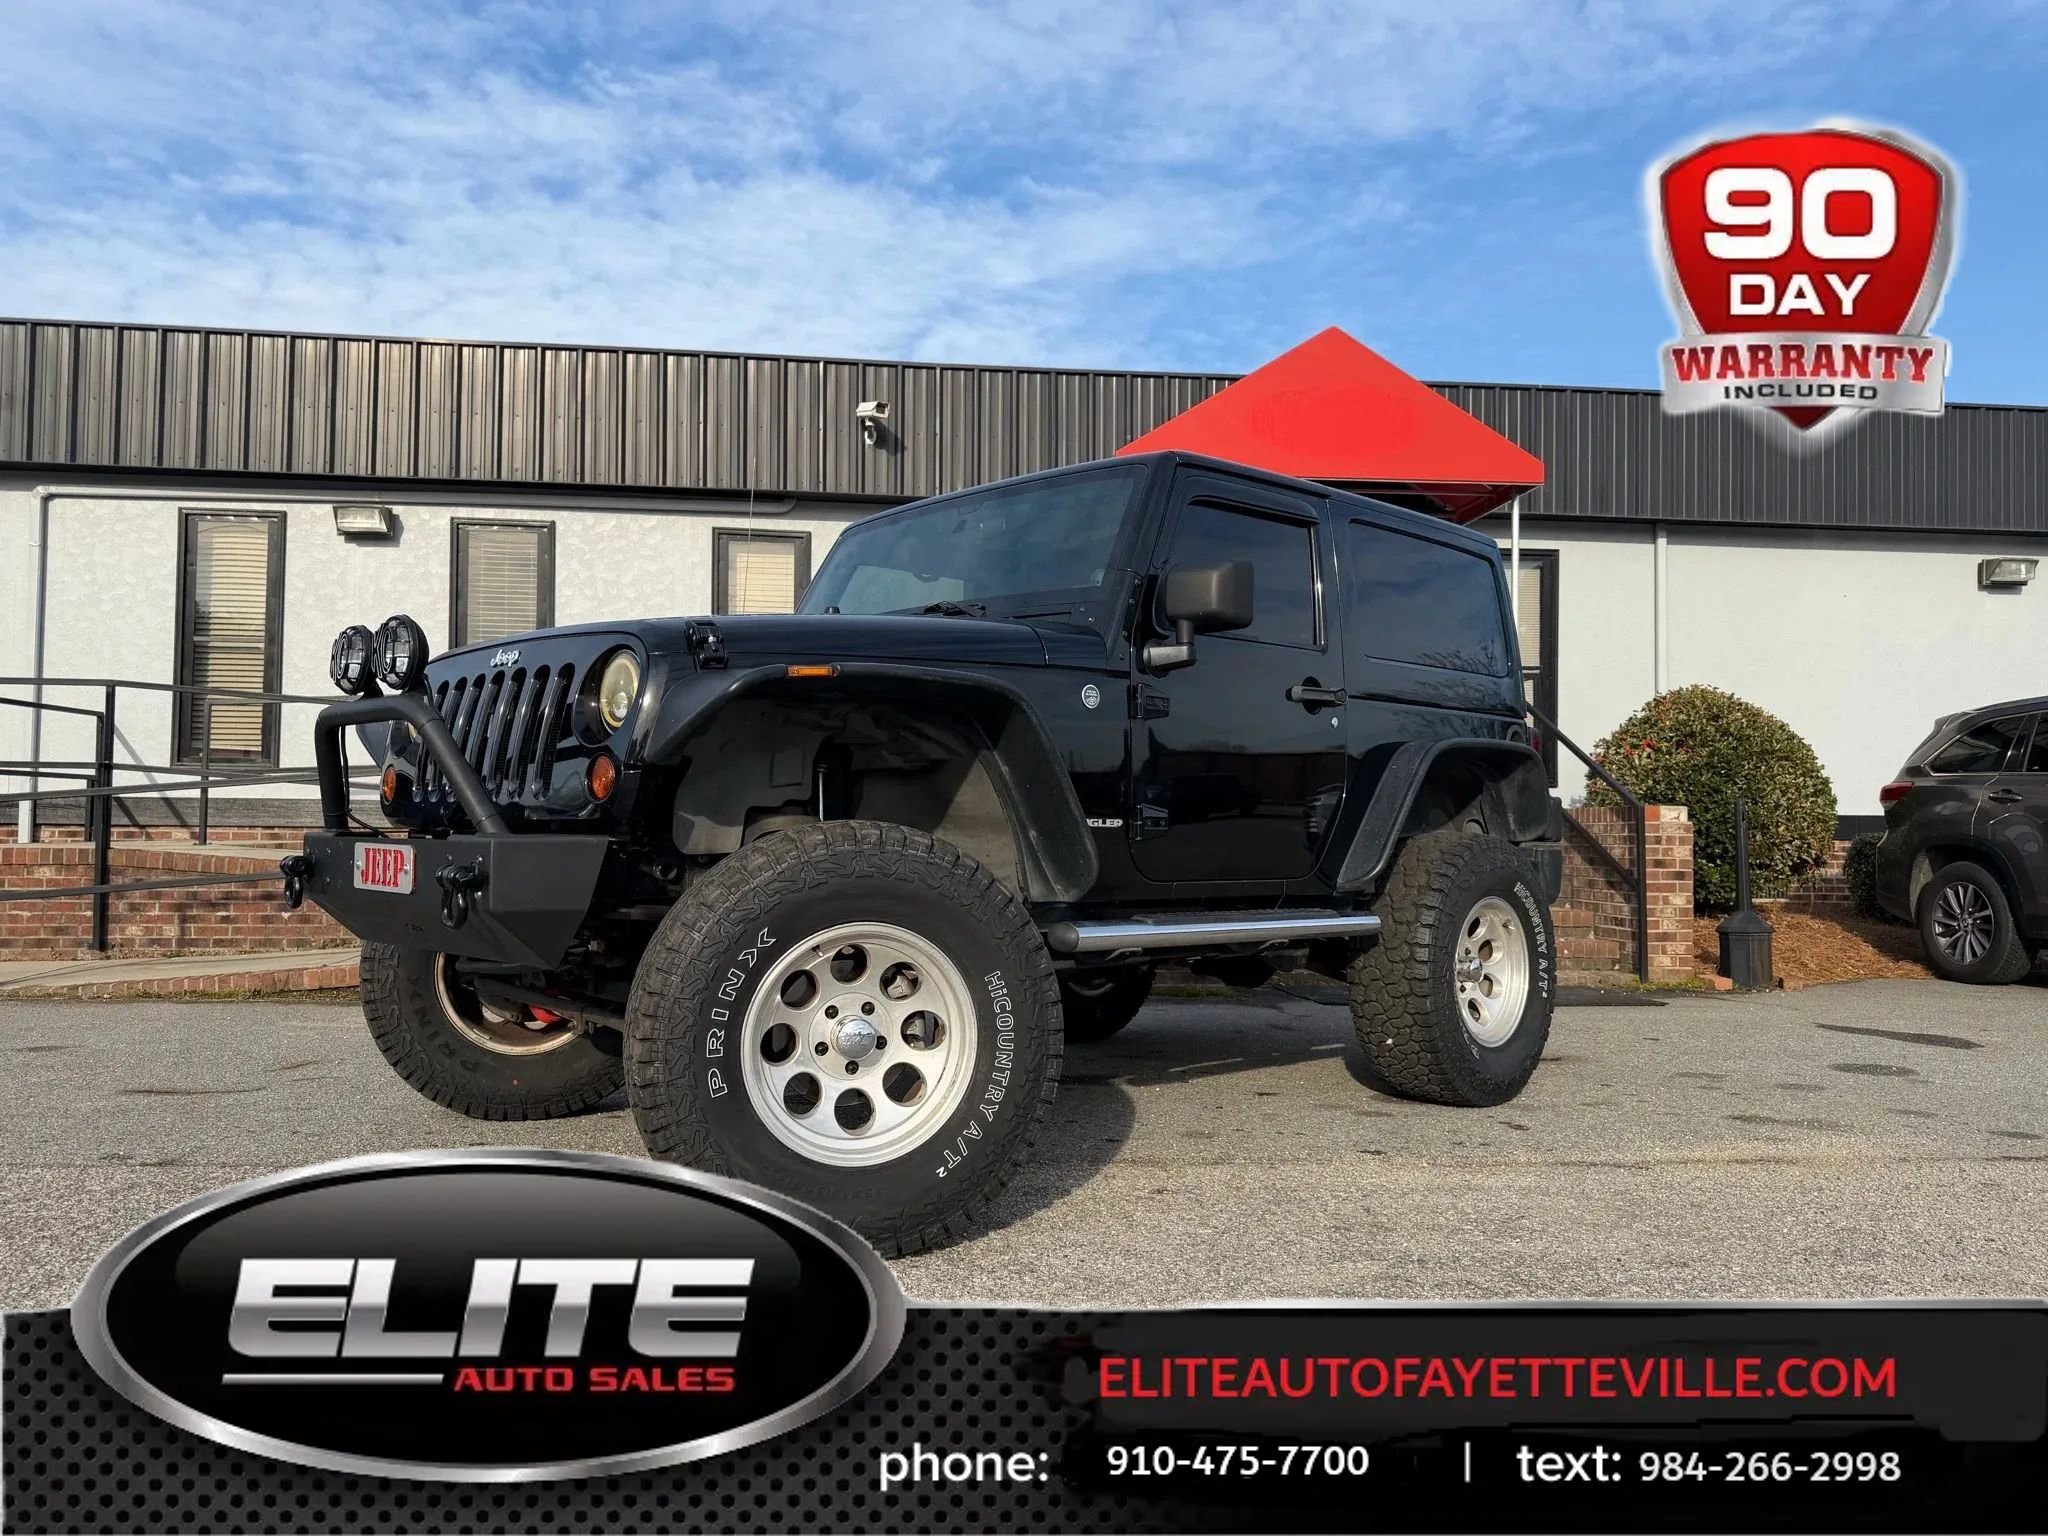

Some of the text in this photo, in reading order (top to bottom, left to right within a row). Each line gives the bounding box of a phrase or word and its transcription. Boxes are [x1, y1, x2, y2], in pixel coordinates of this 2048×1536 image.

[490, 649, 520, 667] Jeep
[361, 847, 405, 888] JEEP
[707, 927, 776, 1098] PRINX
